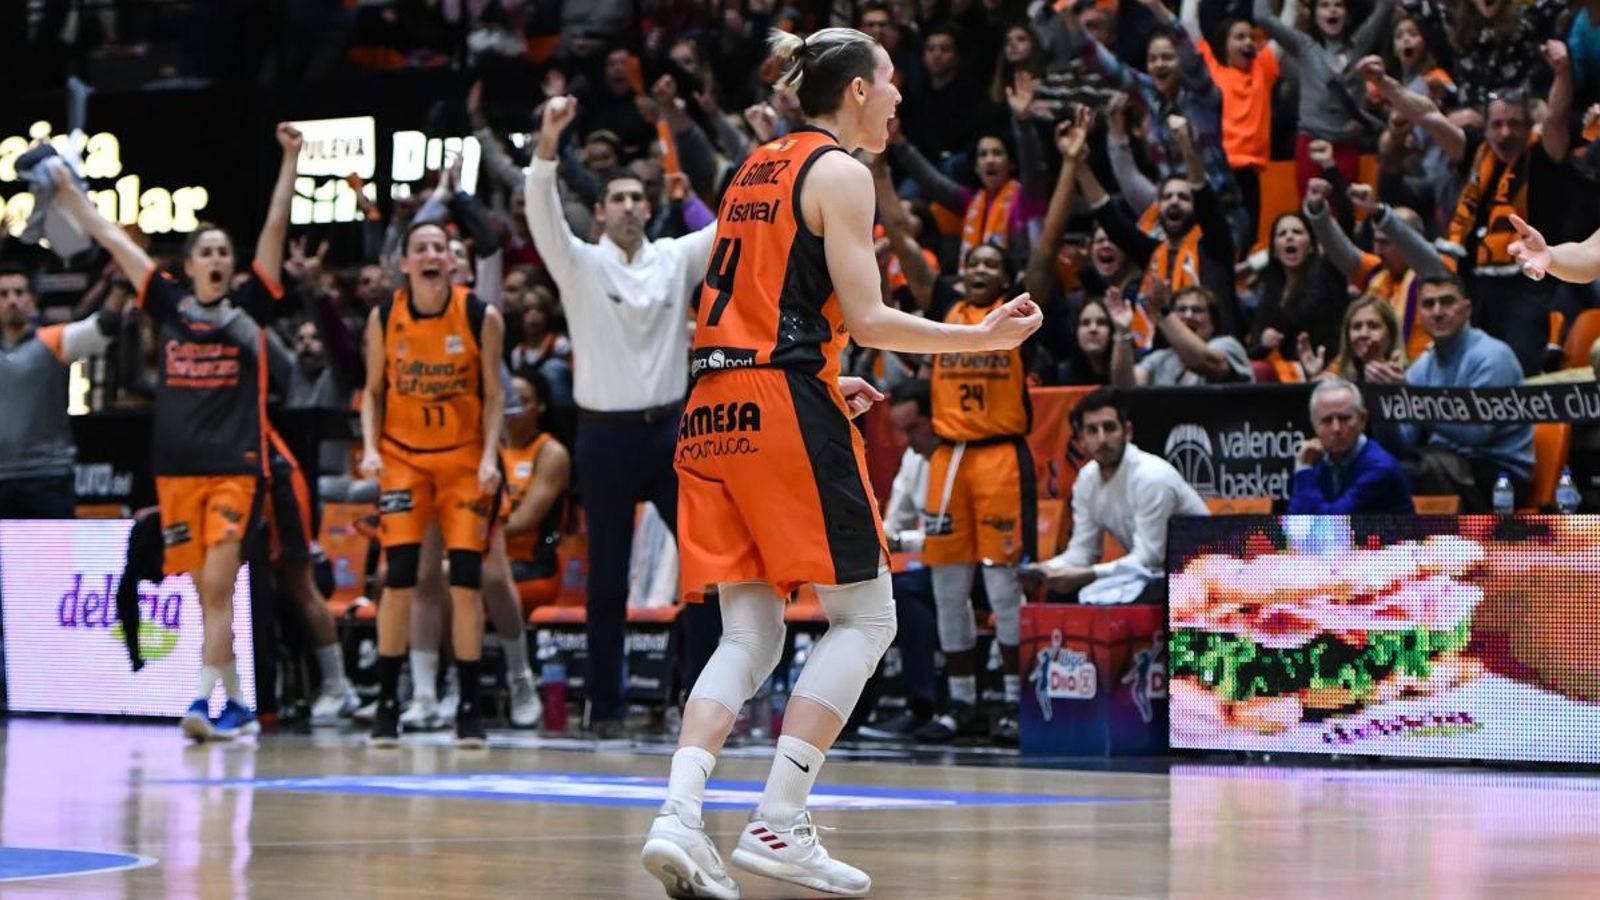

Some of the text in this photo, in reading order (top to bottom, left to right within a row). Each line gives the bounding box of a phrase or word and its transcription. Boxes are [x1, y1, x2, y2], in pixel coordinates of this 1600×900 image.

[726, 198, 780, 224] isaval
[706, 237, 742, 326] 4
[959, 383, 985, 412] 24
[1380, 384, 1600, 421] valencia basket clu
[1218, 421, 1306, 460] valencia
[1220, 463, 1291, 501] basket
